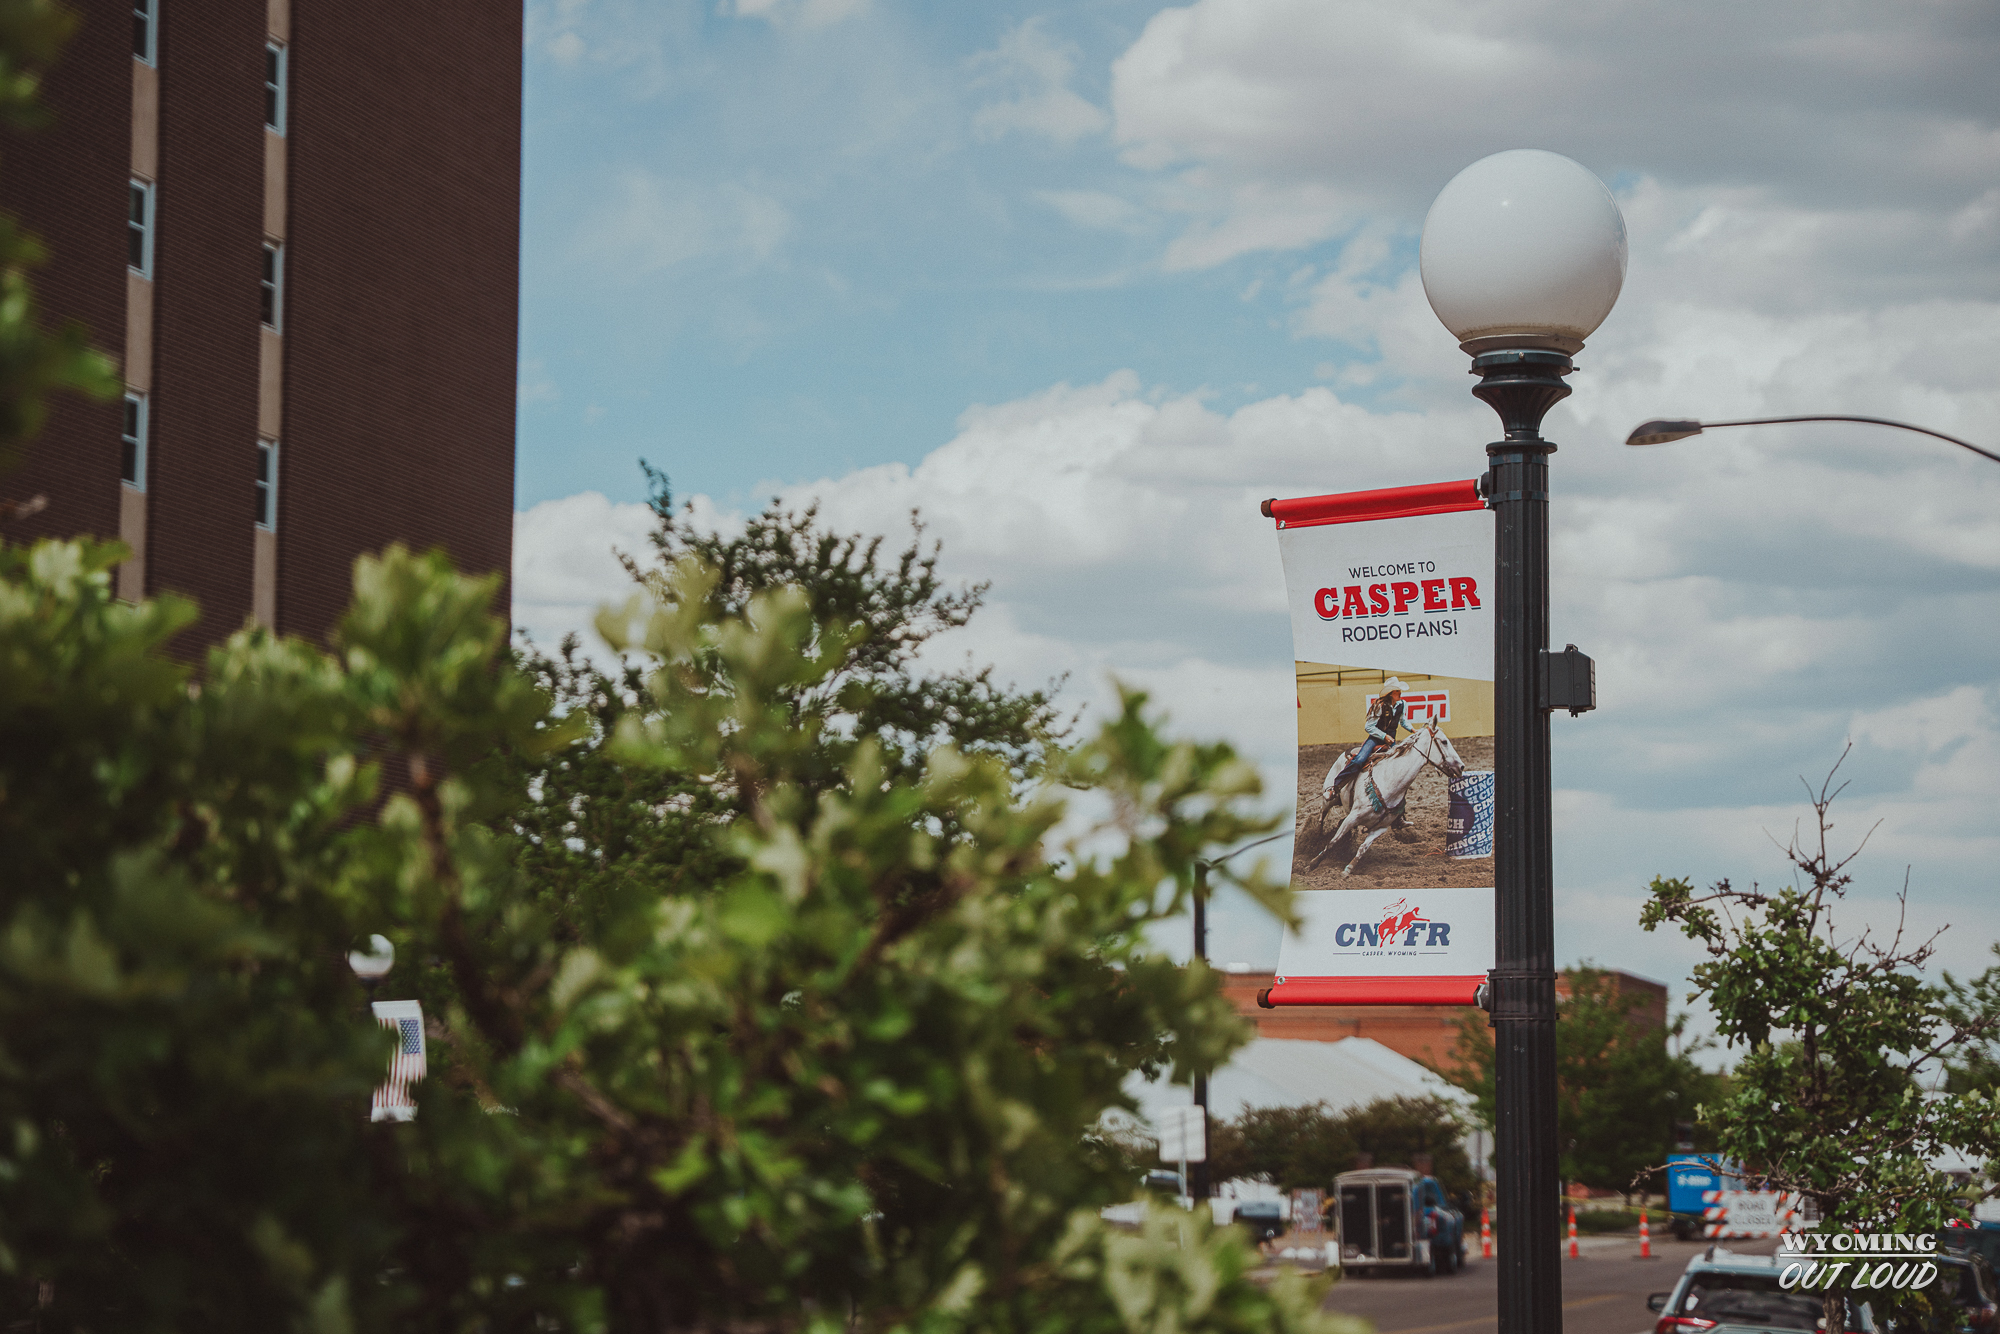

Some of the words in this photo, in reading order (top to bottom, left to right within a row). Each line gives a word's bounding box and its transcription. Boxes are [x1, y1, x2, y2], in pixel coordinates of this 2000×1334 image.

[1348, 563, 1416, 579] WELCOME
[1418, 561, 1436, 573] TO
[1314, 576, 1482, 621] CASPER
[1341, 623, 1402, 643] RODEO
[1406, 619, 1459, 639] FANS!
